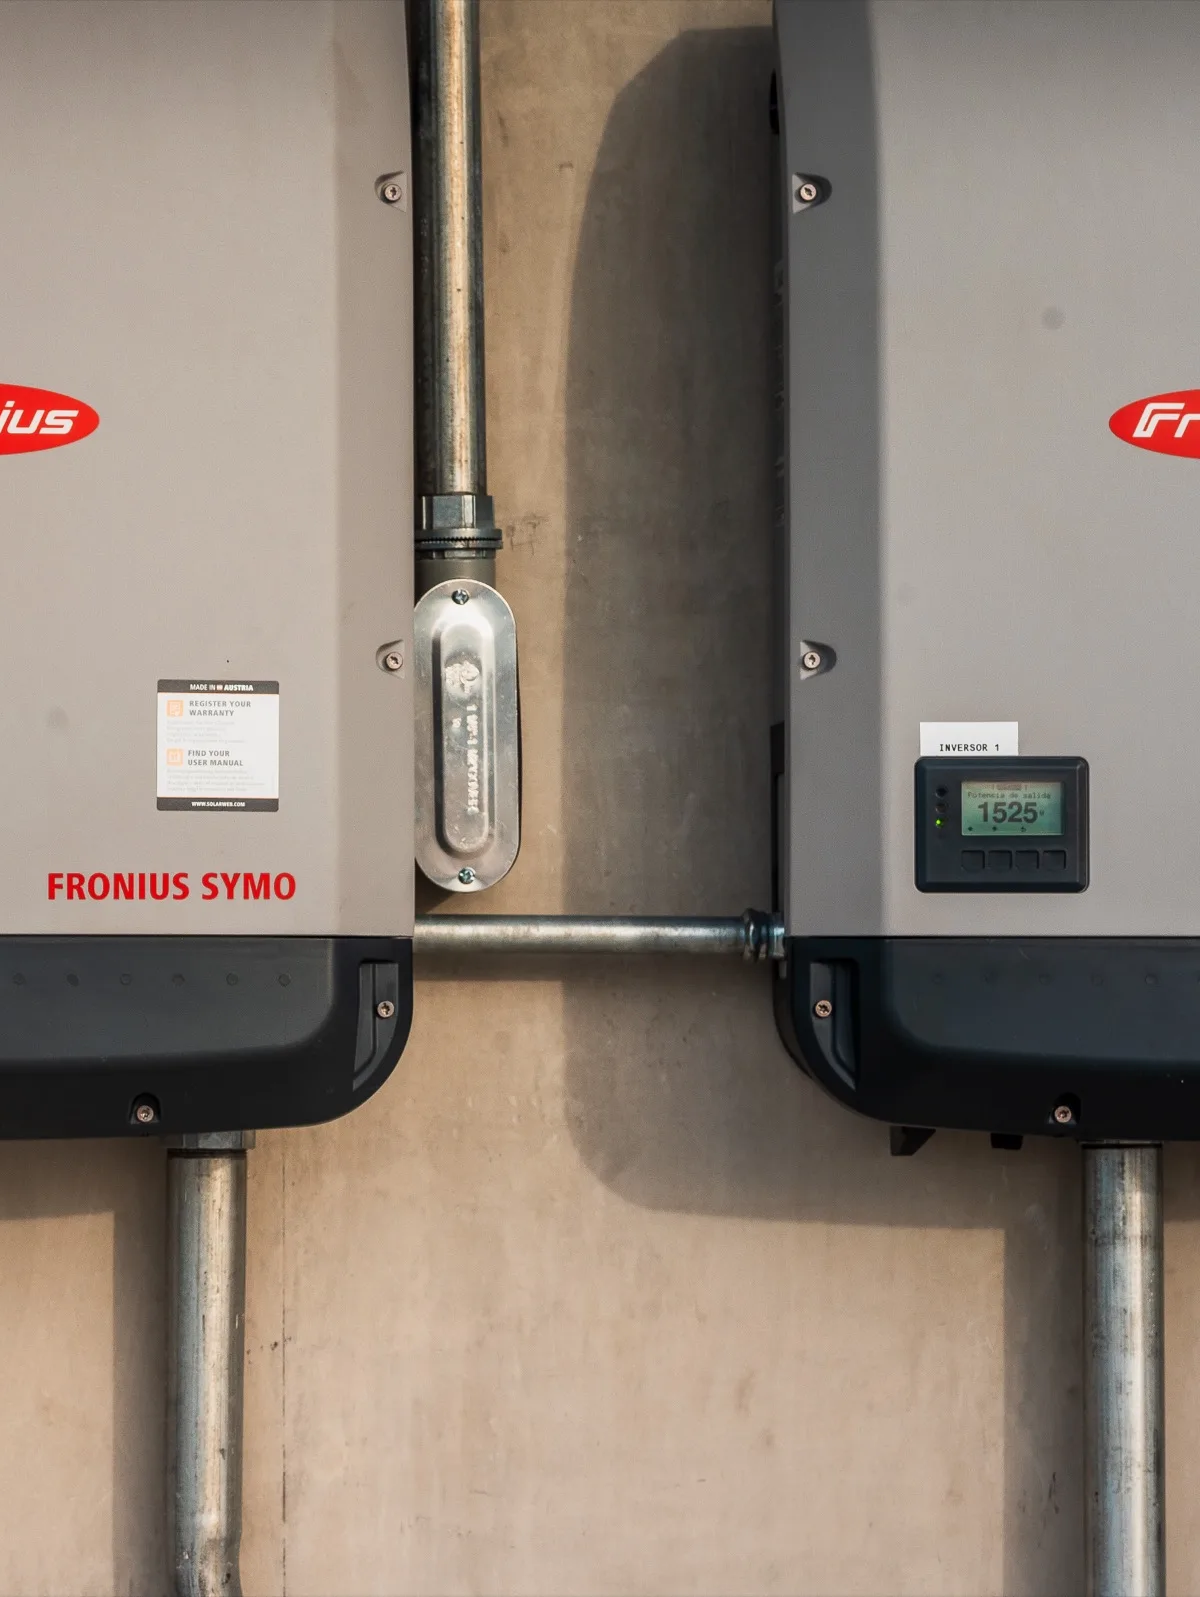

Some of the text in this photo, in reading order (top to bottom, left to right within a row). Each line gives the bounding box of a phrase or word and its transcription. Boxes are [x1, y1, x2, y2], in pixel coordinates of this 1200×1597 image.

[940, 744, 999, 752] INVERSOR 1
[978, 802, 1038, 824] 1525
[47, 872, 296, 900] FRONIUS SYMO
